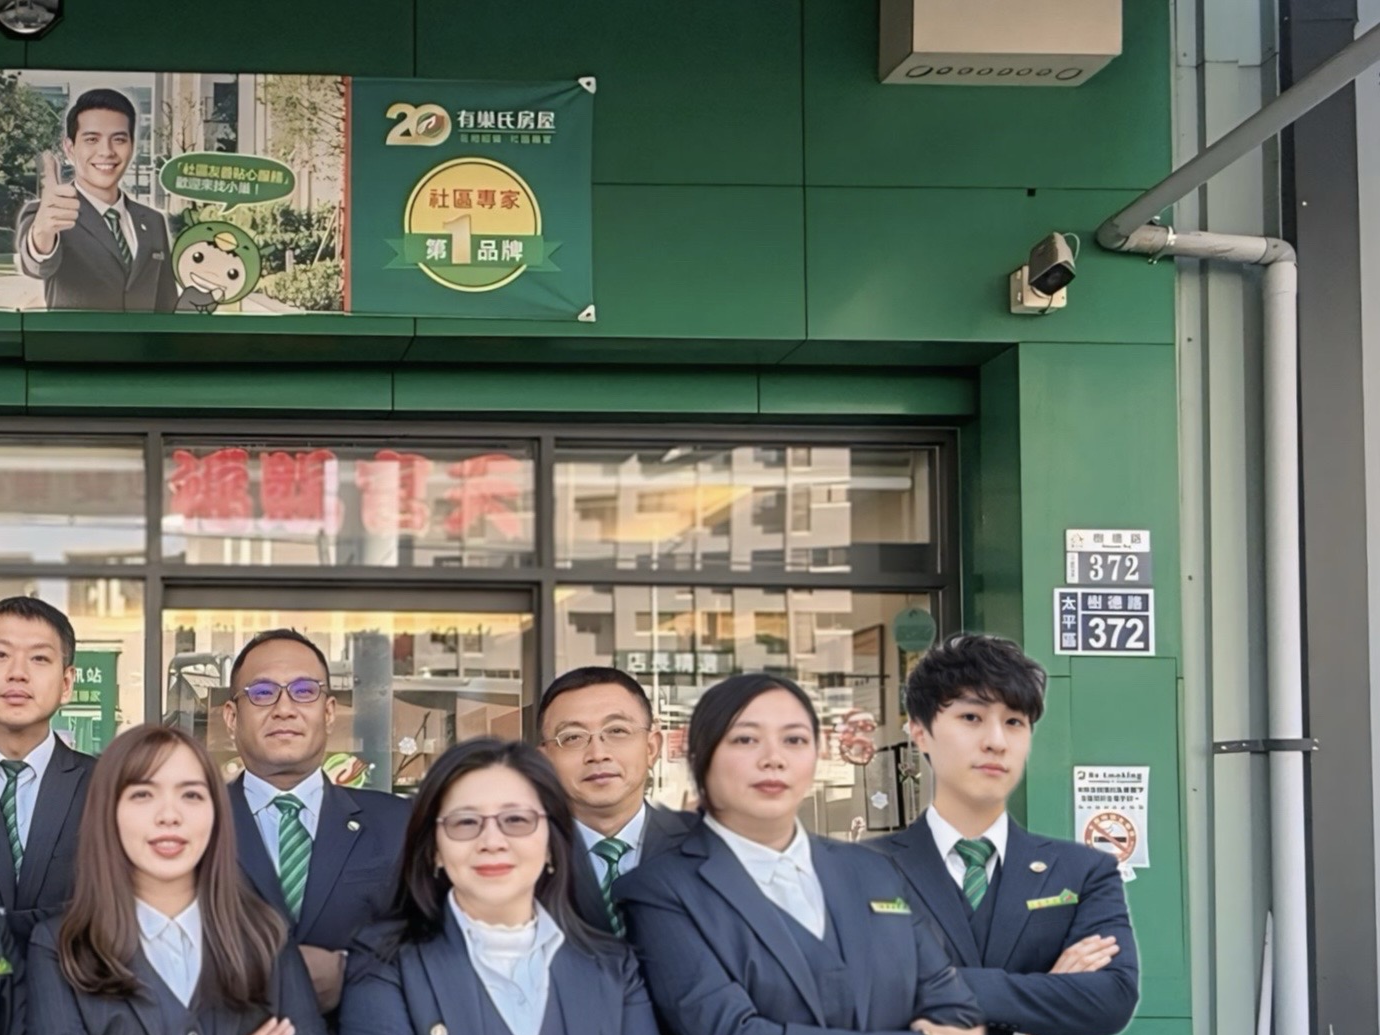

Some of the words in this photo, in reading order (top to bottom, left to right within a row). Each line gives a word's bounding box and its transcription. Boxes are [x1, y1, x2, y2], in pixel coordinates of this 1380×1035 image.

[457, 110, 556, 130] 有巢氏房屋
[429, 188, 521, 210] 社區專家
[1089, 554, 1139, 581] 372
[1088, 617, 1145, 649] 372
